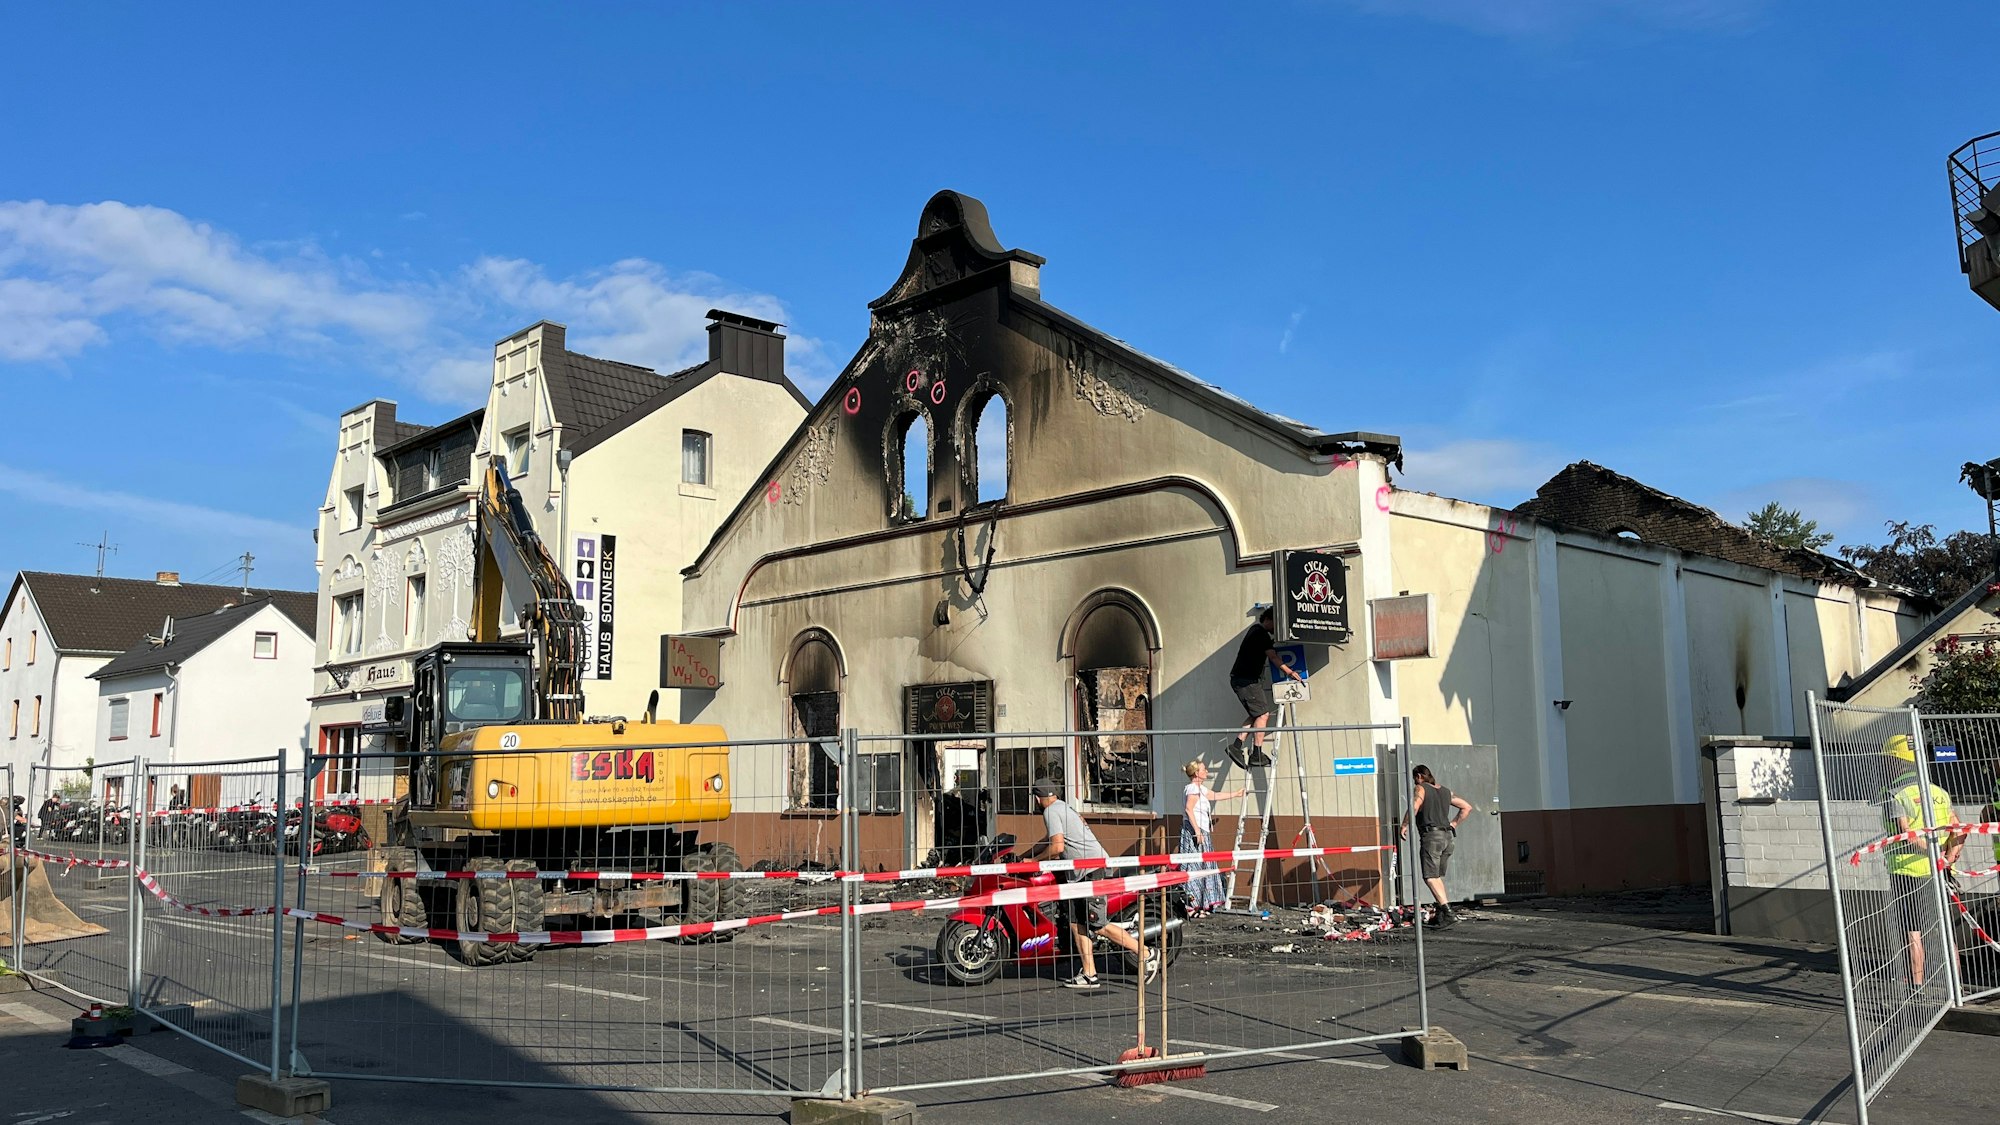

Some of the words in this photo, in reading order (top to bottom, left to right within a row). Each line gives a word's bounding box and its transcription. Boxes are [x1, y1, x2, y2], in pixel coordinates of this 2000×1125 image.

[1303, 560, 1329, 576] CYCLE
[601, 550, 613, 623] SONNECK
[1297, 602, 1319, 613] POINT
[1321, 604, 1341, 615] WEST
[599, 632, 612, 674] HAUS
[368, 666, 395, 682] Haus
[936, 687, 956, 699] CYCLE
[504, 735, 516, 748] 20
[571, 749, 654, 783] ESKA
